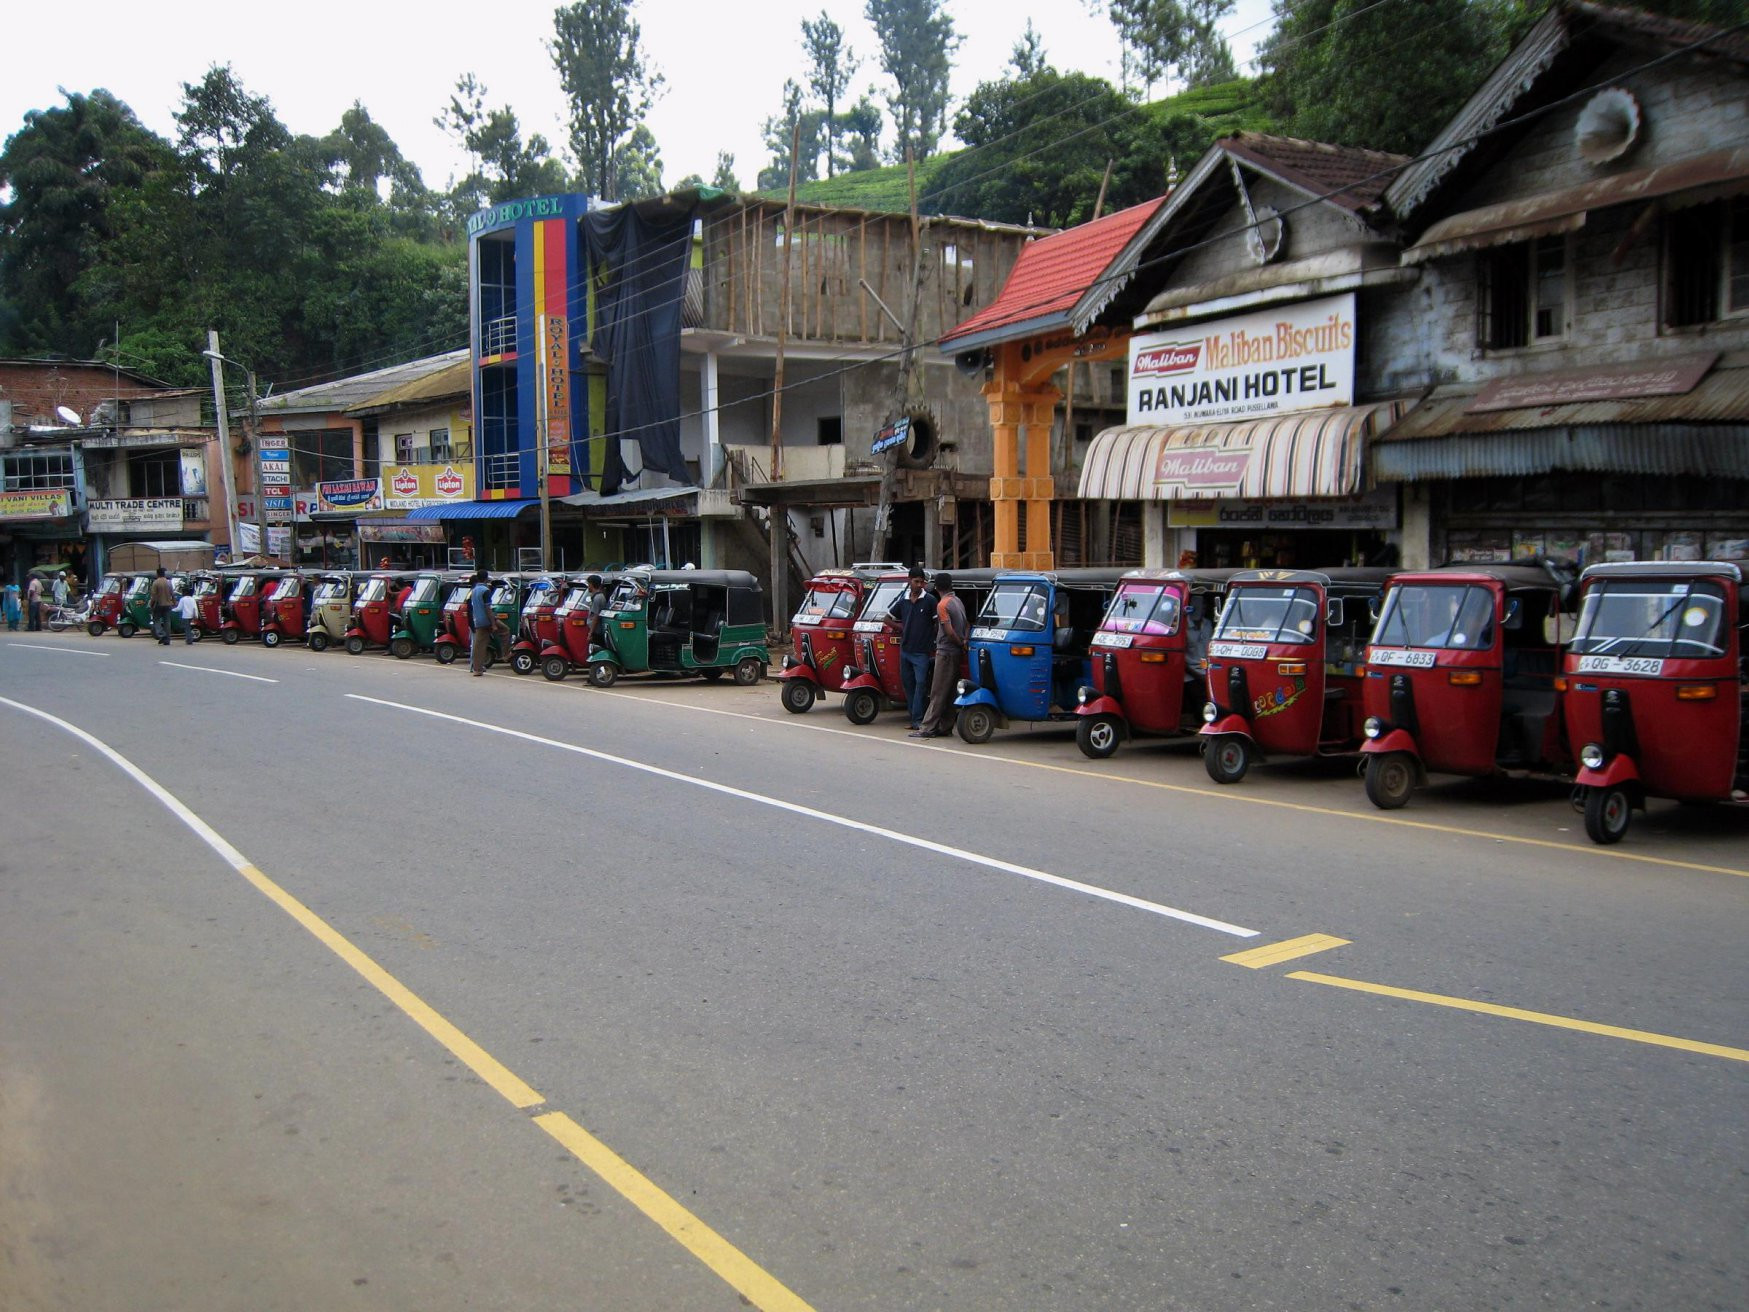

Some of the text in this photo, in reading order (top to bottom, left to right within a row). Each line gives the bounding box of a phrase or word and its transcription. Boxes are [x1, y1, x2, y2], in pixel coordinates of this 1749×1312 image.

[499, 198, 563, 223] HOTEL
[550, 318, 563, 358] ROYAL
[1204, 312, 1352, 372] Maliban Biscuits
[1136, 350, 1197, 372] Maliban
[551, 368, 565, 407] HOTEL
[1138, 363, 1337, 412] RANJANI HOTEL
[261, 439, 286, 447] INGER
[263, 463, 284, 471] AKAI
[1161, 454, 1239, 476] Maliban
[265, 487, 283, 495] TCL
[395, 480, 416, 490] Lipton
[439, 480, 460, 490] Lipton
[89, 499, 181, 510] MULTI TRADE CENTRE
